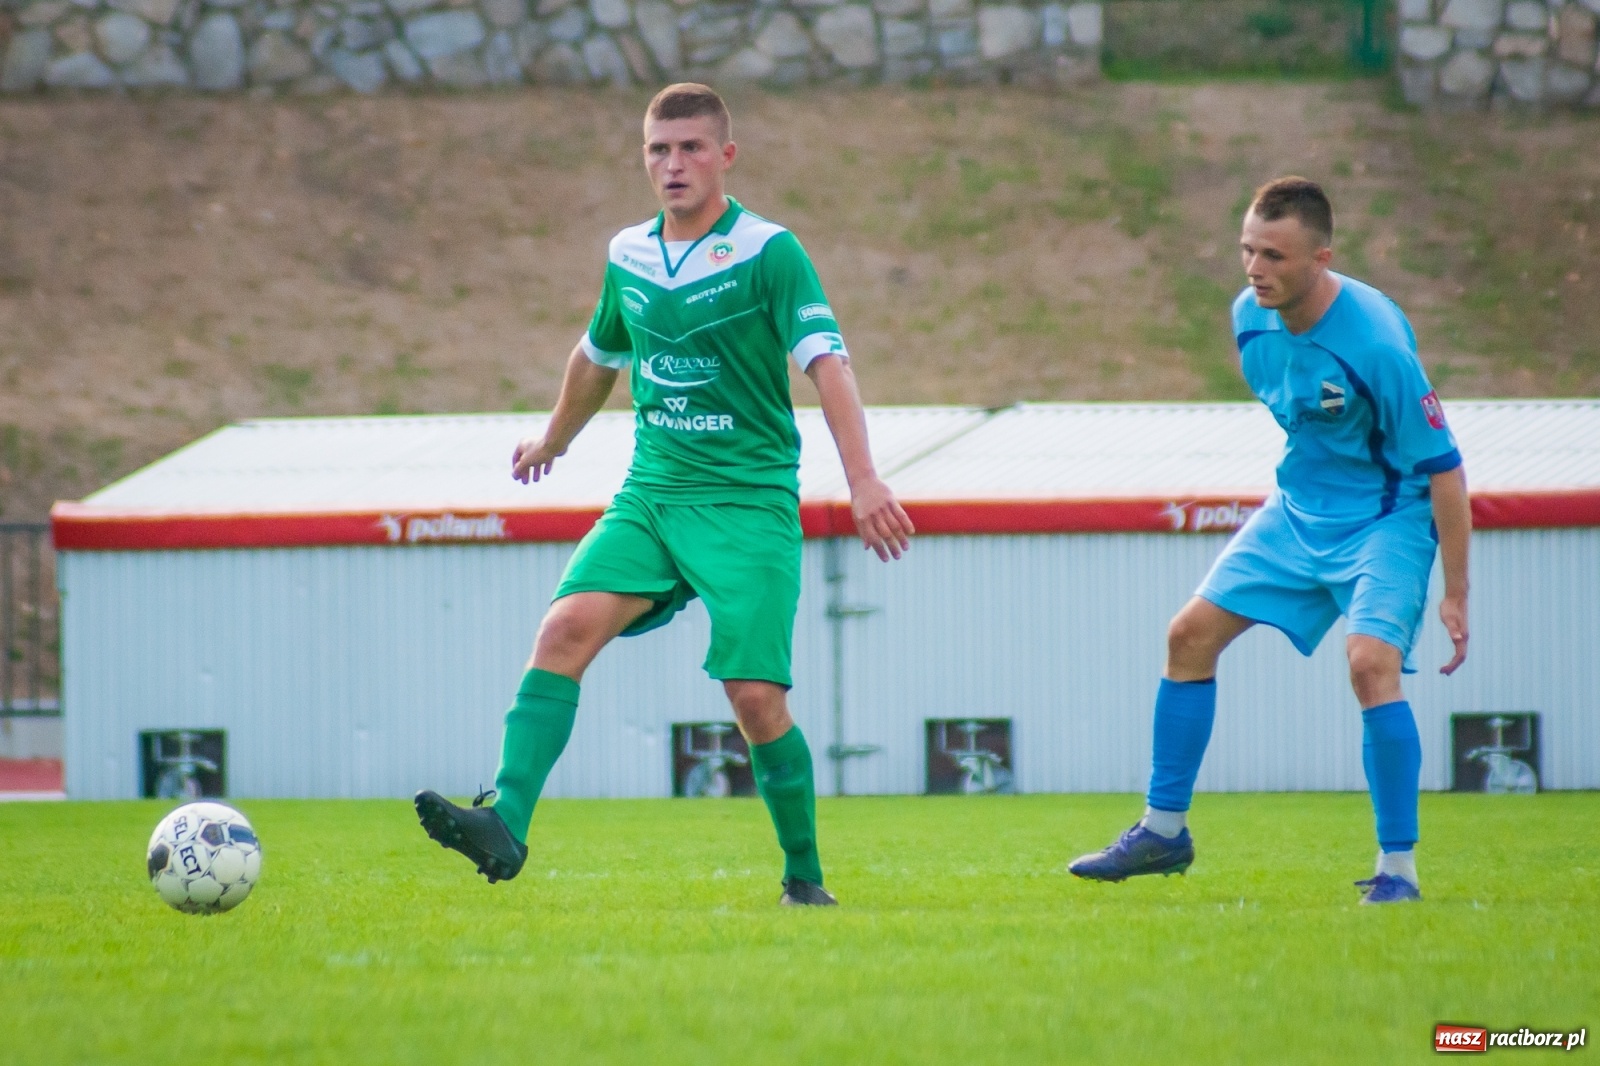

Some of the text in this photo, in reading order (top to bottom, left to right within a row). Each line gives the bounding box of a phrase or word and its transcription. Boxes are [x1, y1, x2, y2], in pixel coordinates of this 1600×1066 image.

[685, 279, 738, 304] GROTRANS
[407, 512, 506, 542] polanik
[174, 816, 188, 839] SEL
[180, 846, 201, 875] ECT
